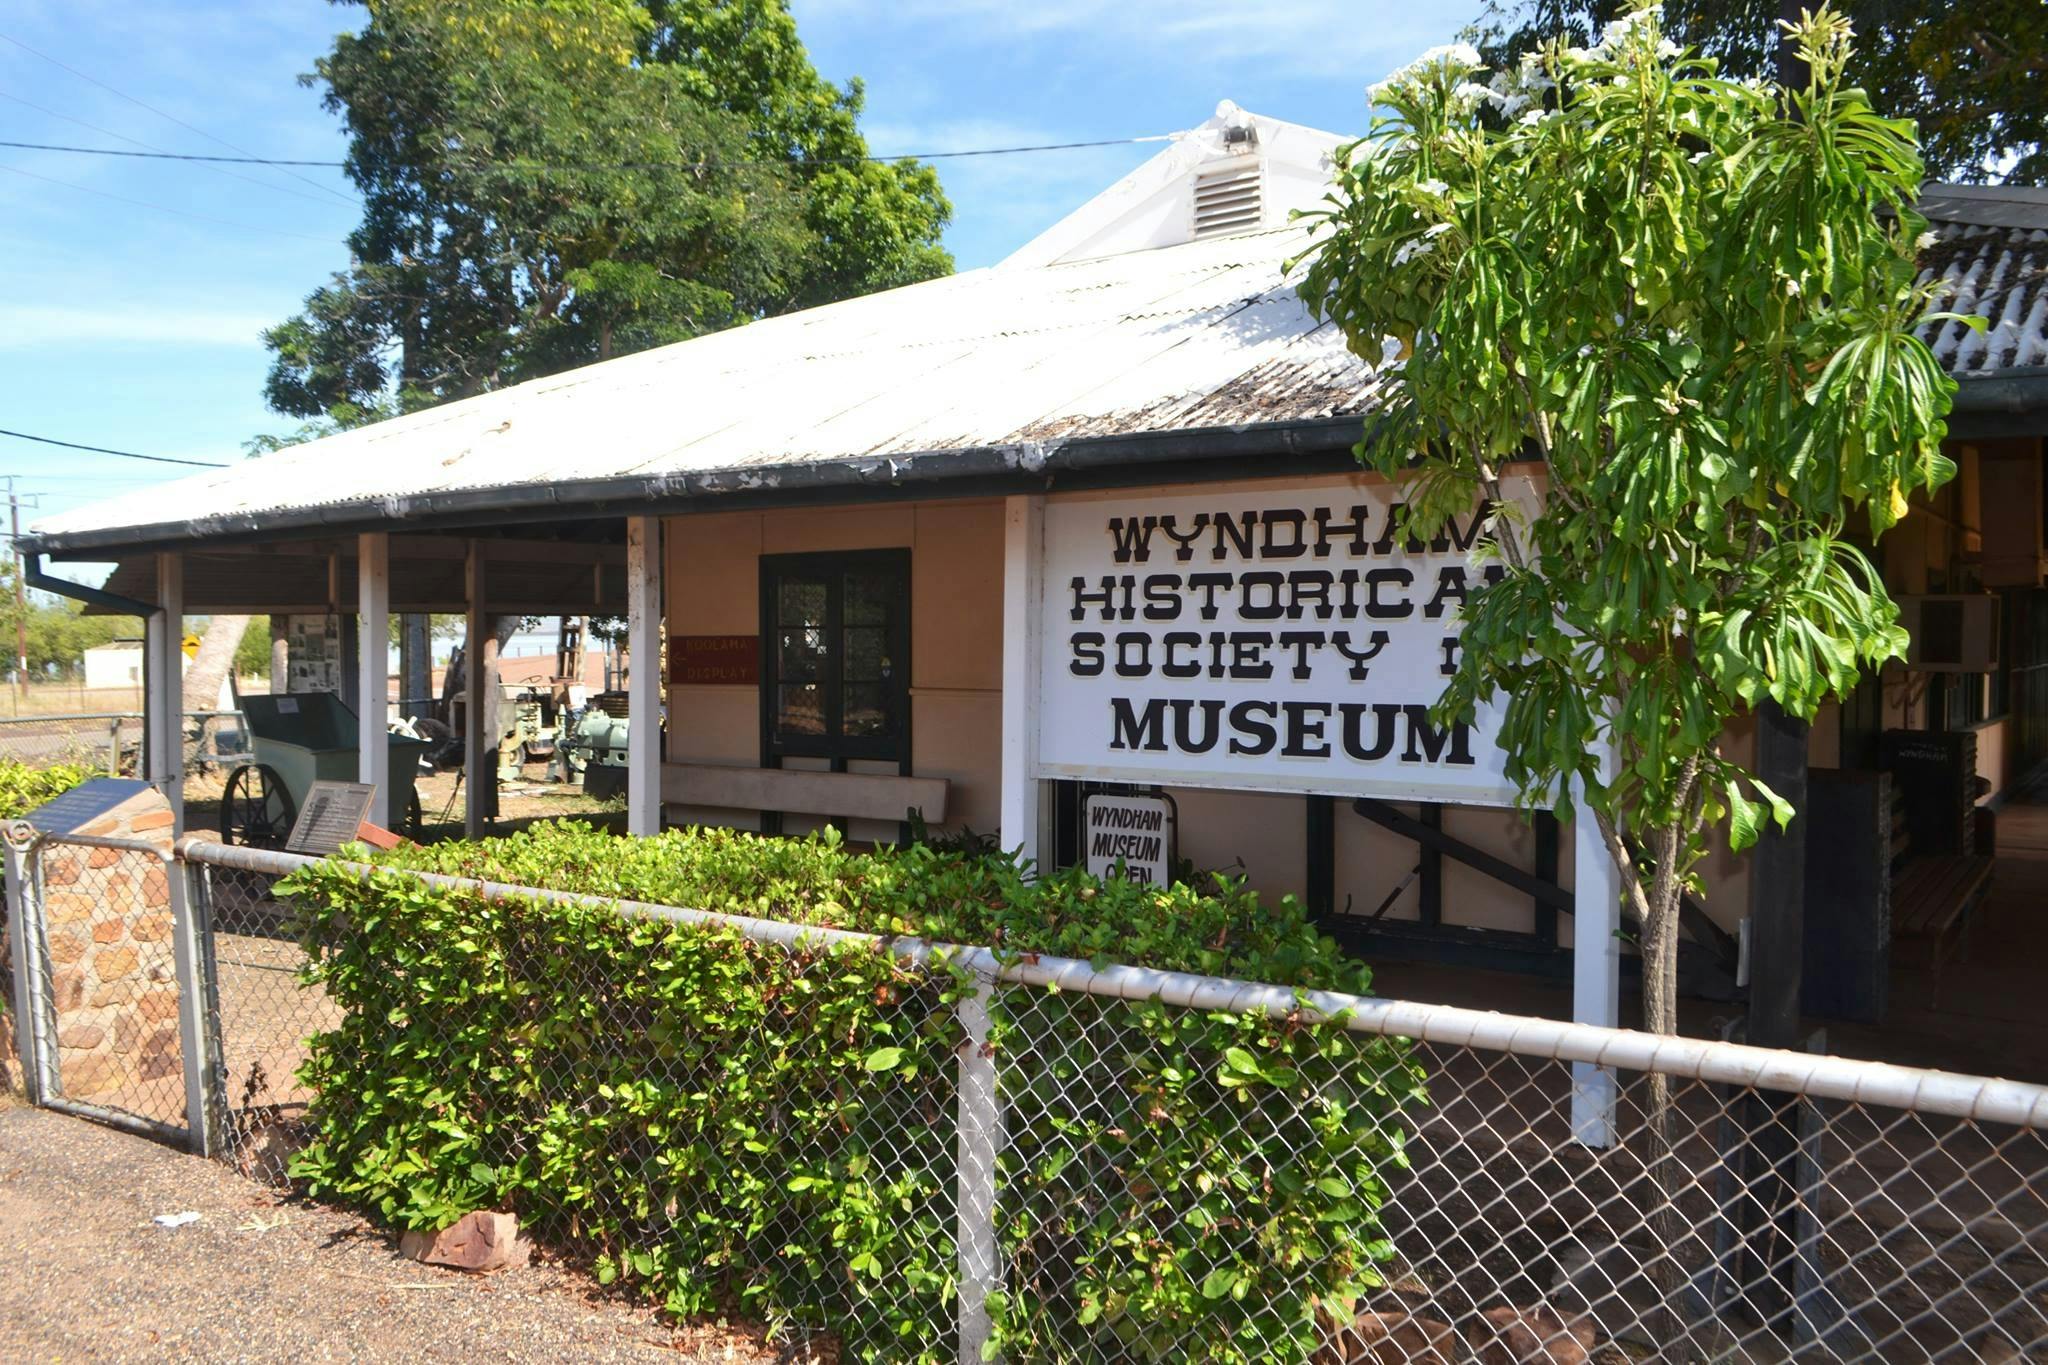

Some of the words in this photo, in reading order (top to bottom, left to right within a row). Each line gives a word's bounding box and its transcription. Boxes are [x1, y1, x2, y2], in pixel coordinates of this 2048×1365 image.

[1108, 499, 1504, 563] WYNDHAM
[1070, 565, 1506, 621] HISTORICA
[687, 666, 747, 680] DISPLAY
[1070, 630, 1390, 681] SOCIETY
[1110, 697, 1476, 765] MUSEUM
[1092, 806, 1163, 832] WYNDHAM
[1092, 833, 1162, 862] MUSEUM
